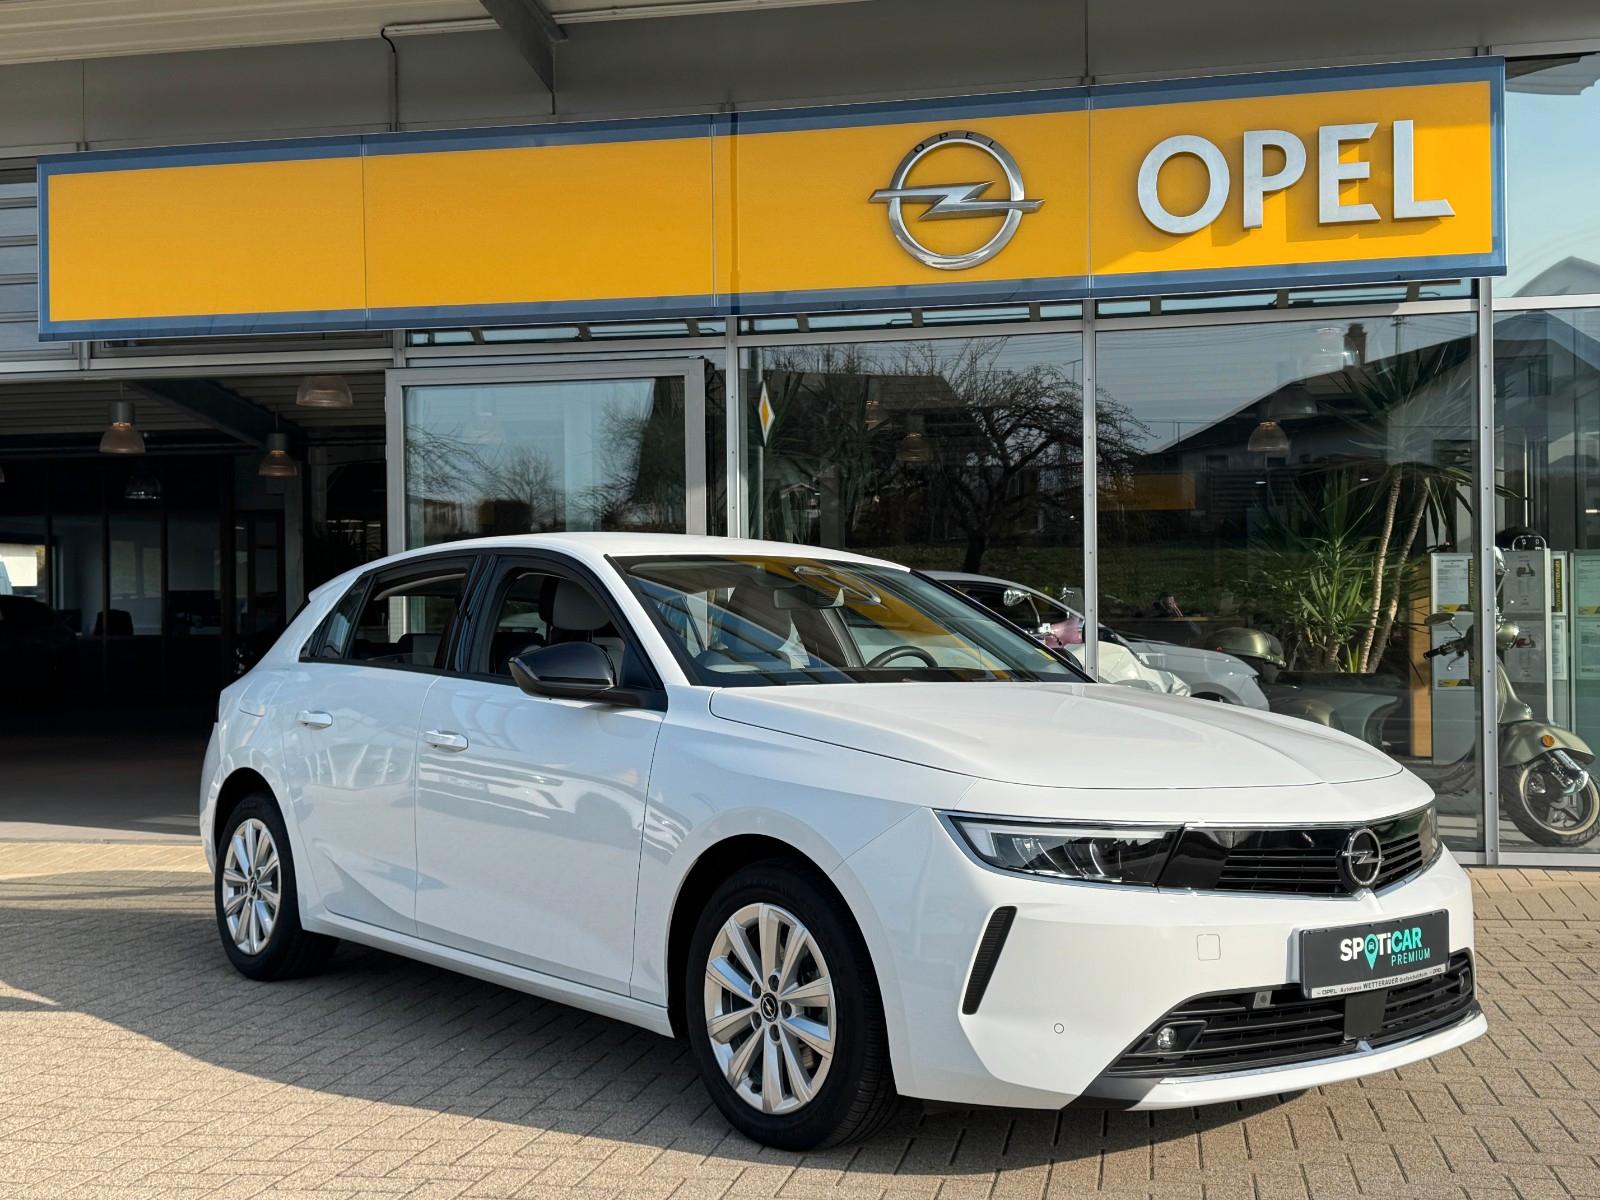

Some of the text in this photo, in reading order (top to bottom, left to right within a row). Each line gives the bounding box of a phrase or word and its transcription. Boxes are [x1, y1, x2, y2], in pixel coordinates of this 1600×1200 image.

[914, 131, 996, 153] OPEL
[1137, 119, 1455, 235] OPEL
[1391, 947, 1431, 967] PREMIUM
[1363, 978, 1399, 989] WETTERAUER
